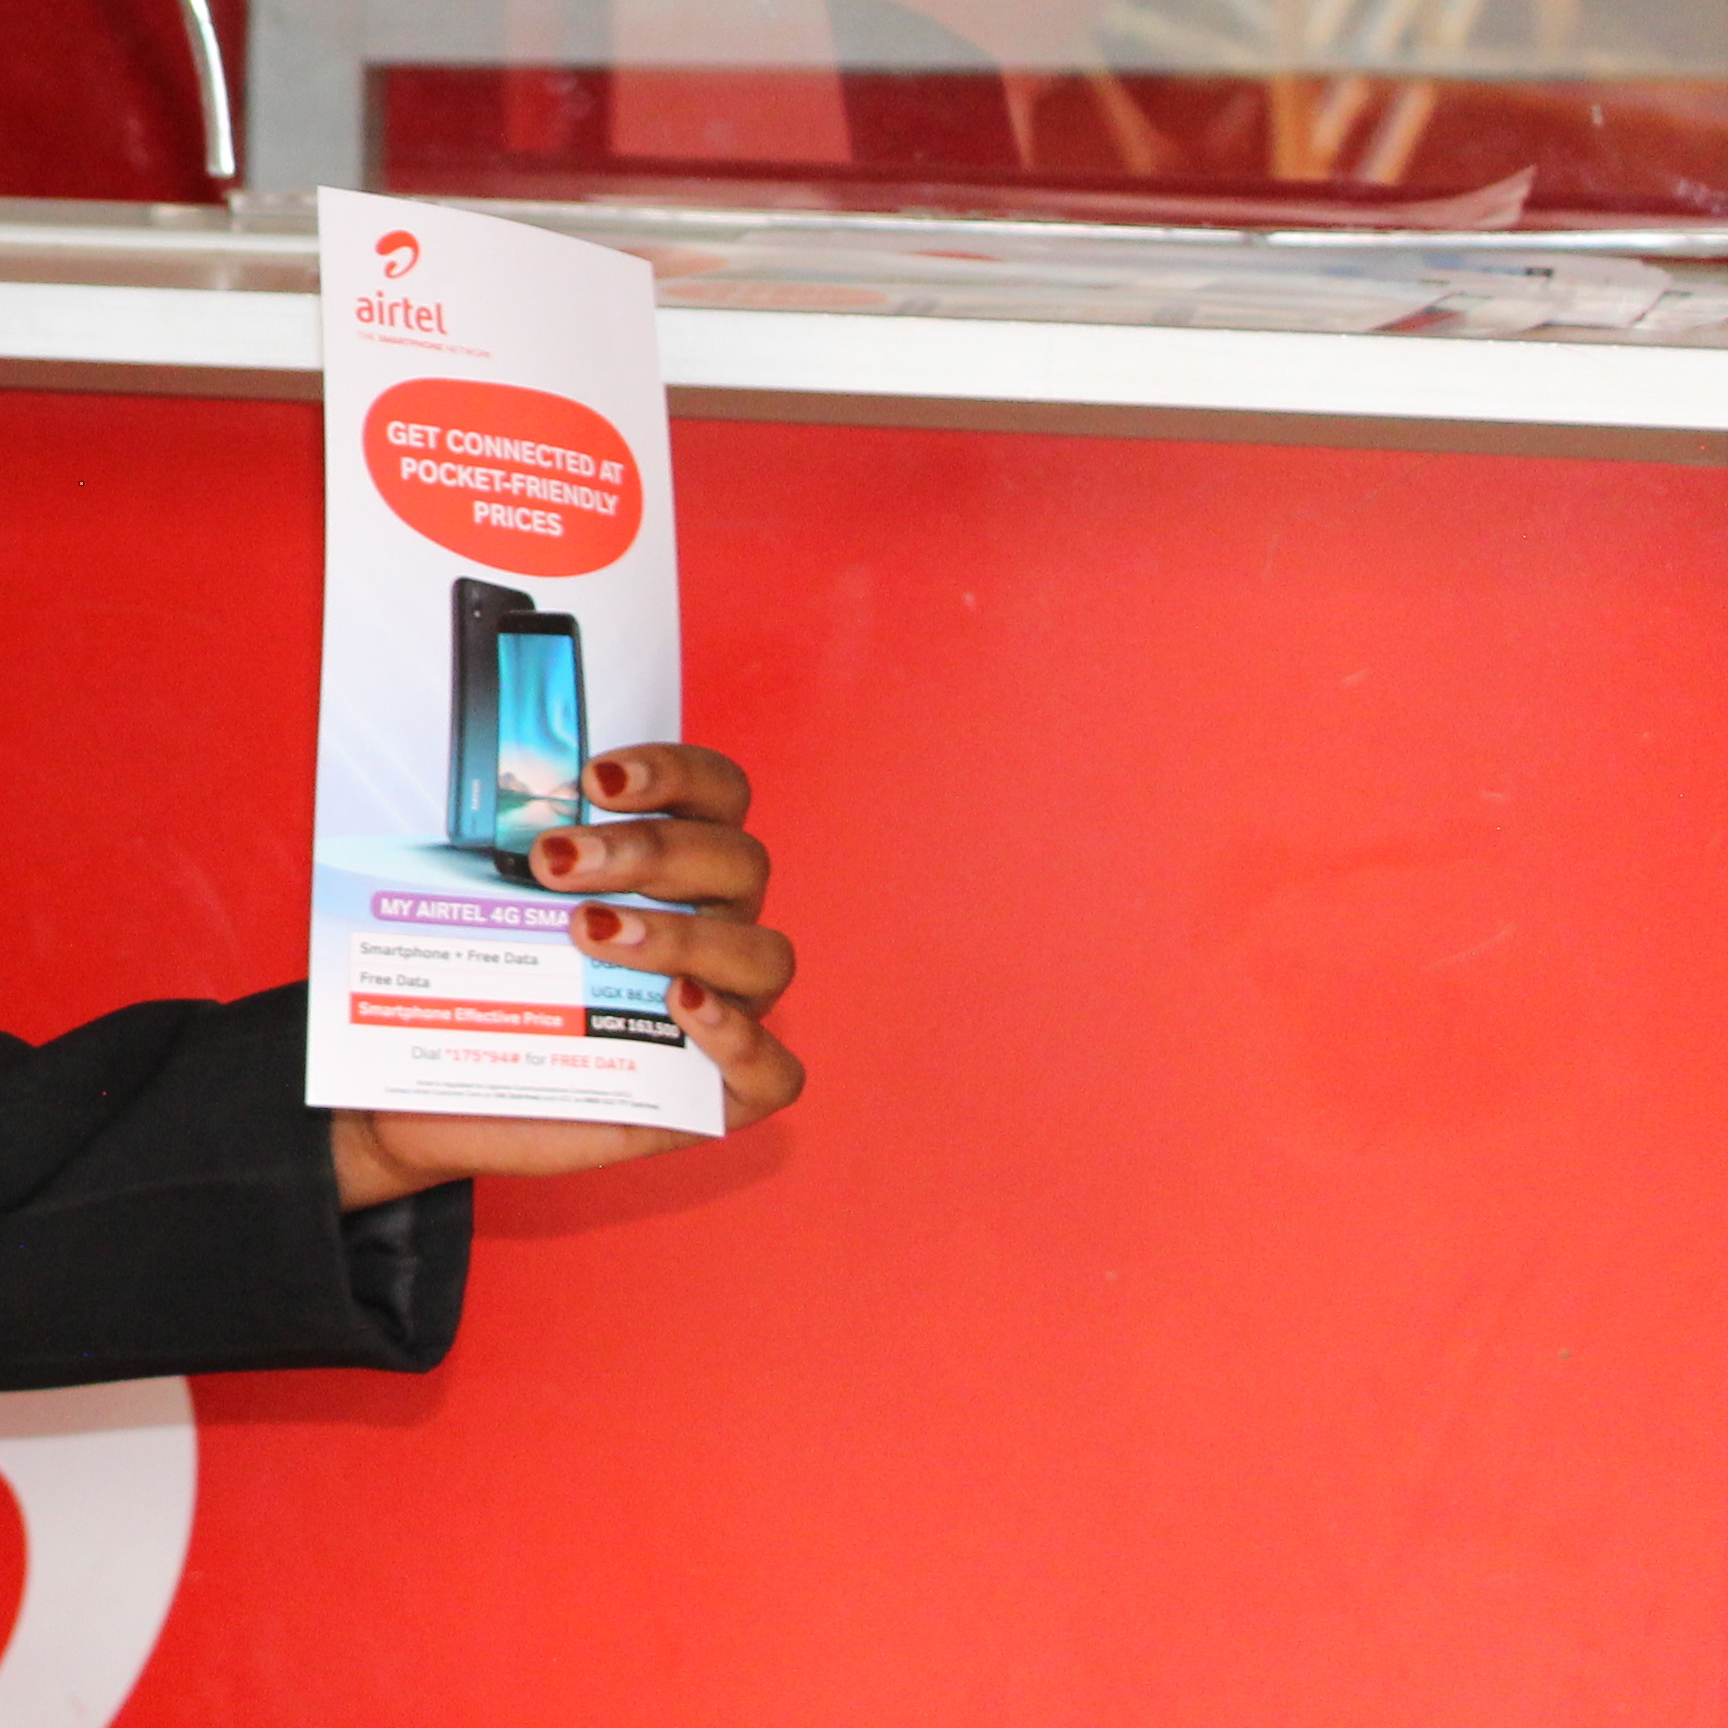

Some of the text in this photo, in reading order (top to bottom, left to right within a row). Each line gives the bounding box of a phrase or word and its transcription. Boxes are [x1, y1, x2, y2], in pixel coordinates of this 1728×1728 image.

[355, 290, 448, 335] airtel
[386, 420, 624, 485] GET CONNECTED AT
[400, 456, 621, 515] POCKET-FRIENDLY
[472, 500, 564, 537] PRICES
[379, 897, 571, 926] MY AIRTEL 4G SMA
[360, 942, 451, 961] Smartphone
[467, 949, 501, 964] Free
[504, 952, 539, 966] Data
[359, 972, 392, 986] Free
[396, 974, 431, 988] Data
[591, 986, 622, 999] UGX
[358, 1002, 452, 1021] Smartphone
[455, 1007, 521, 1026] Effective
[522, 1011, 564, 1028] Price
[591, 1014, 627, 1031] UGX
[411, 1045, 441, 1061] Dial
[525, 1052, 548, 1066] for
[550, 1052, 591, 1069] FREE
[595, 1055, 637, 1072] DATA
